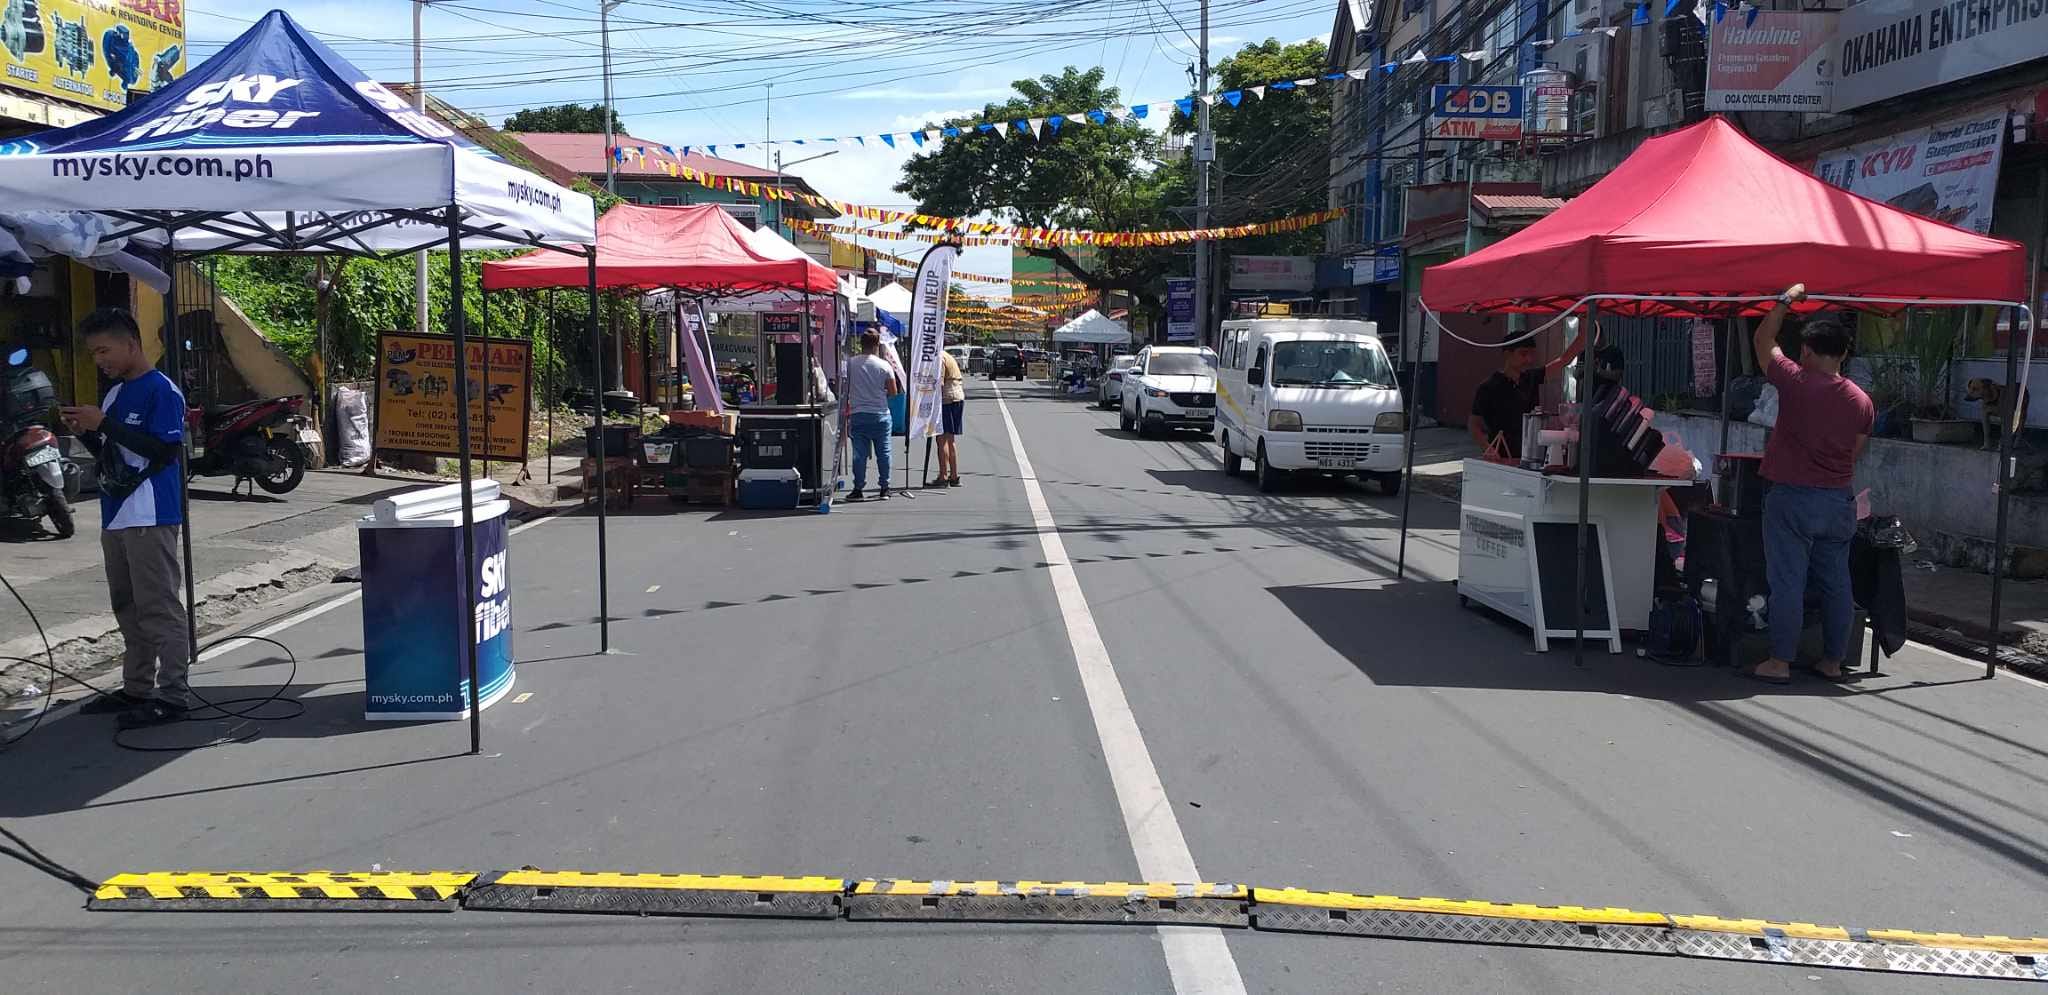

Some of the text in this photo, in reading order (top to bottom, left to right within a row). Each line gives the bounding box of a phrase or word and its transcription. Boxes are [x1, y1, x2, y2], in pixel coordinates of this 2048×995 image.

[118, 10, 157, 30] REWINDING
[159, 24, 182, 38] CENTER
[1723, 26, 1801, 45] Havoline
[1842, 14, 1922, 77] OKAHANA
[176, 73, 304, 113] SKY
[1742, 94, 1767, 104] CYCLE
[1768, 94, 1792, 105] PARTS
[1793, 95, 1822, 105] CENTER
[119, 107, 321, 142] fiber
[1440, 121, 1476, 137] ATM
[52, 154, 274, 181] mysky.com.ph
[507, 179, 561, 214] mysky.com.ph
[921, 270, 939, 363] POWERLINEUP
[408, 408, 424, 419] Tel:
[481, 549, 507, 598] SKY
[371, 693, 453, 704] mysky.com.ph
